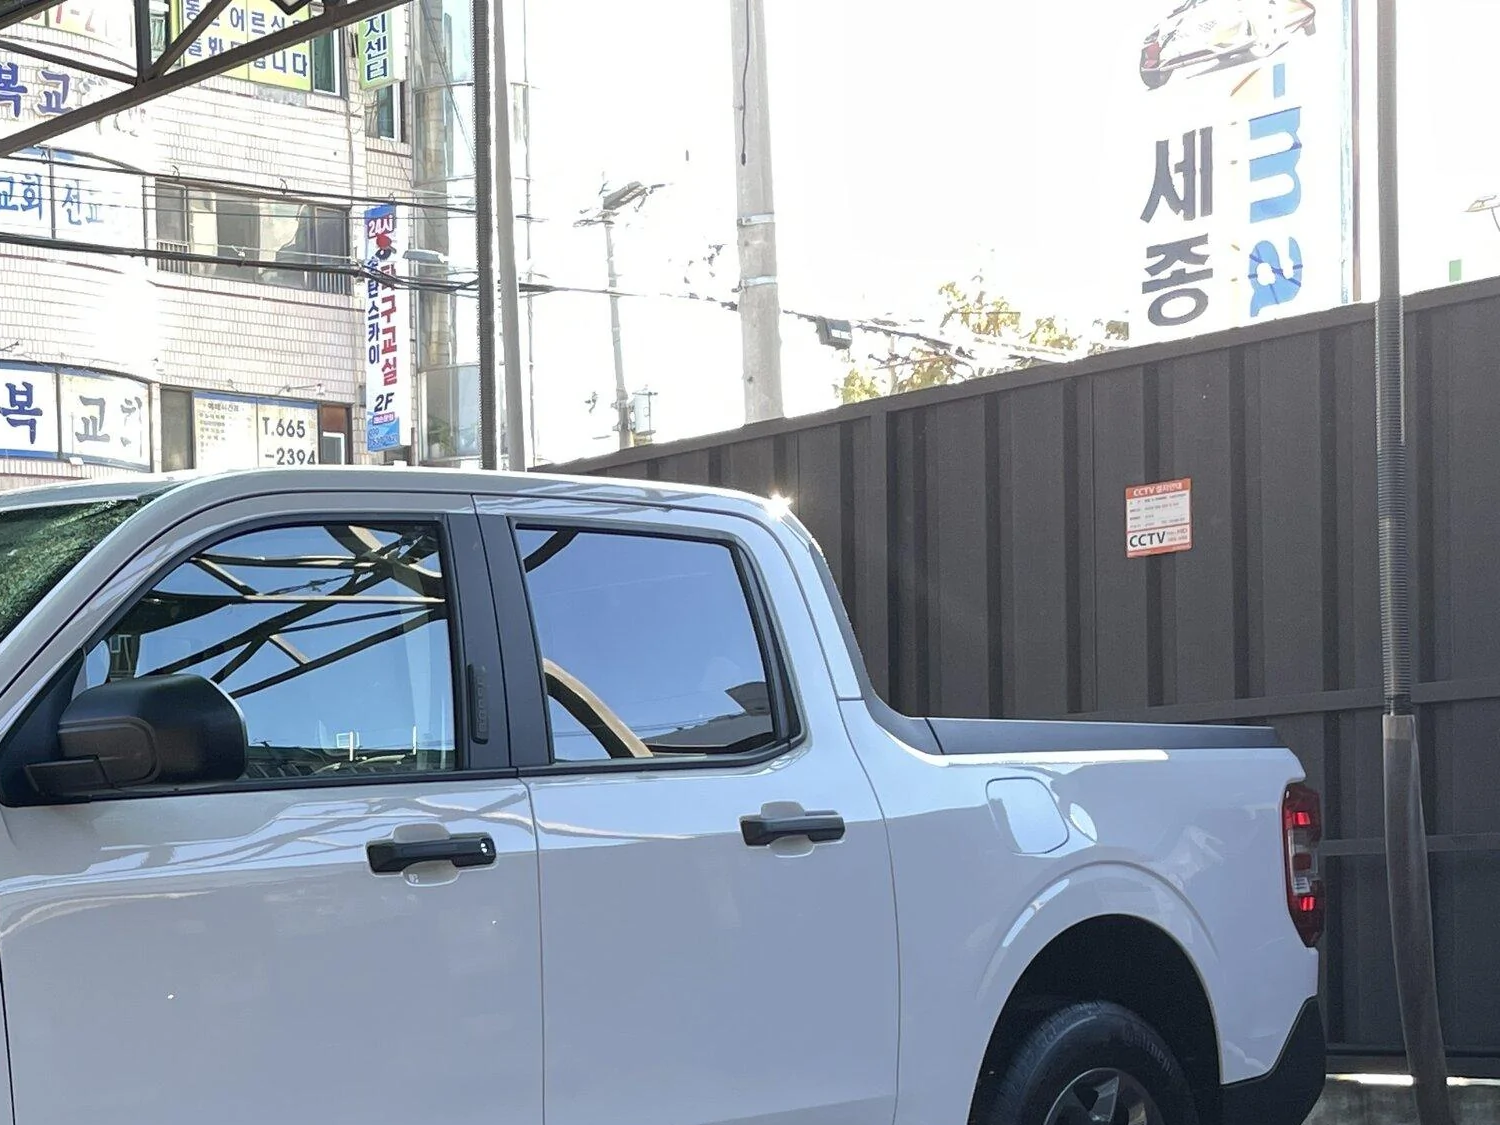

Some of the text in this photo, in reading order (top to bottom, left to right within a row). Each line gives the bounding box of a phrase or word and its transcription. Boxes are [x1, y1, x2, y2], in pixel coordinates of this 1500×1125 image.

[230, 7, 302, 38] 어르신
[1140, 126, 1213, 327] 세종
[374, 392, 395, 412] 2F
[262, 416, 306, 439] T.665
[265, 447, 316, 466] -2394
[1133, 487, 1155, 496] CCTV
[1129, 531, 1166, 548] CCTV
